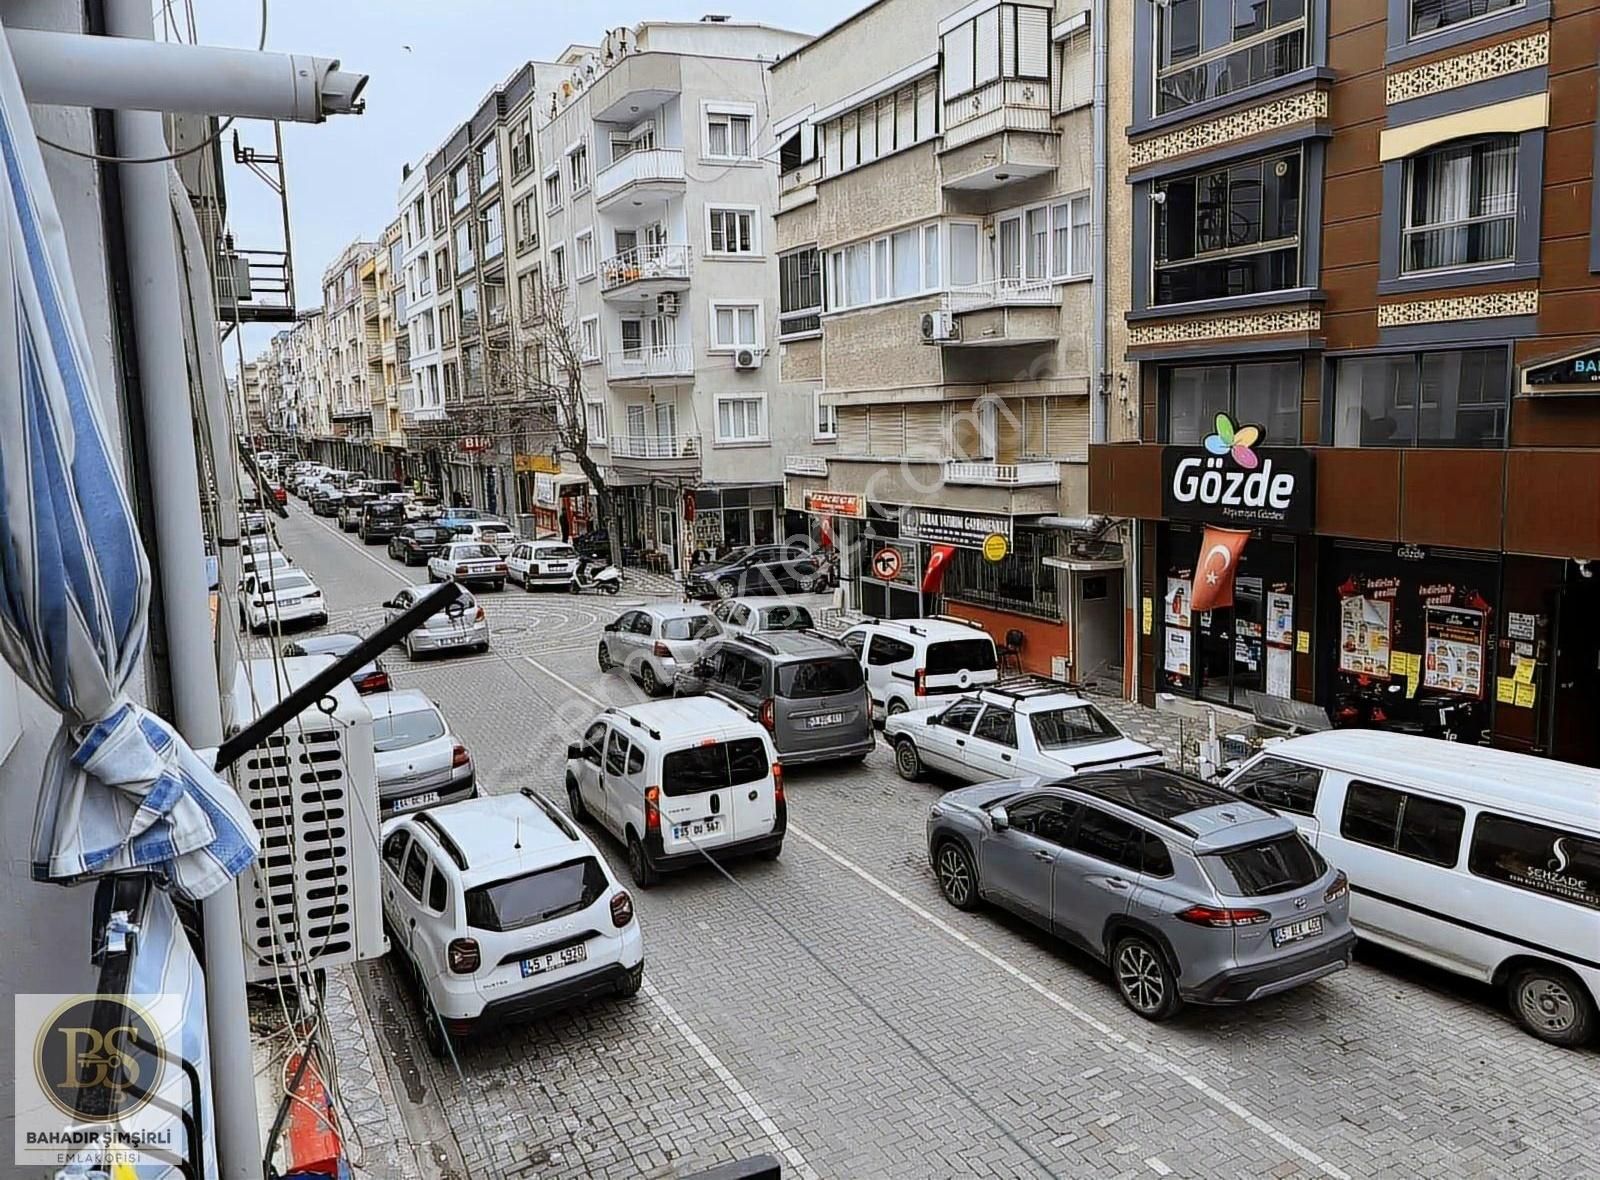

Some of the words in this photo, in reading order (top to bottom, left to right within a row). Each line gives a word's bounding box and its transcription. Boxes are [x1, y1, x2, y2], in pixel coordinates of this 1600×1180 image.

[1575, 360, 1600, 373] BA
[1173, 457, 1295, 509] Gözde
[545, 954, 553, 966] P
